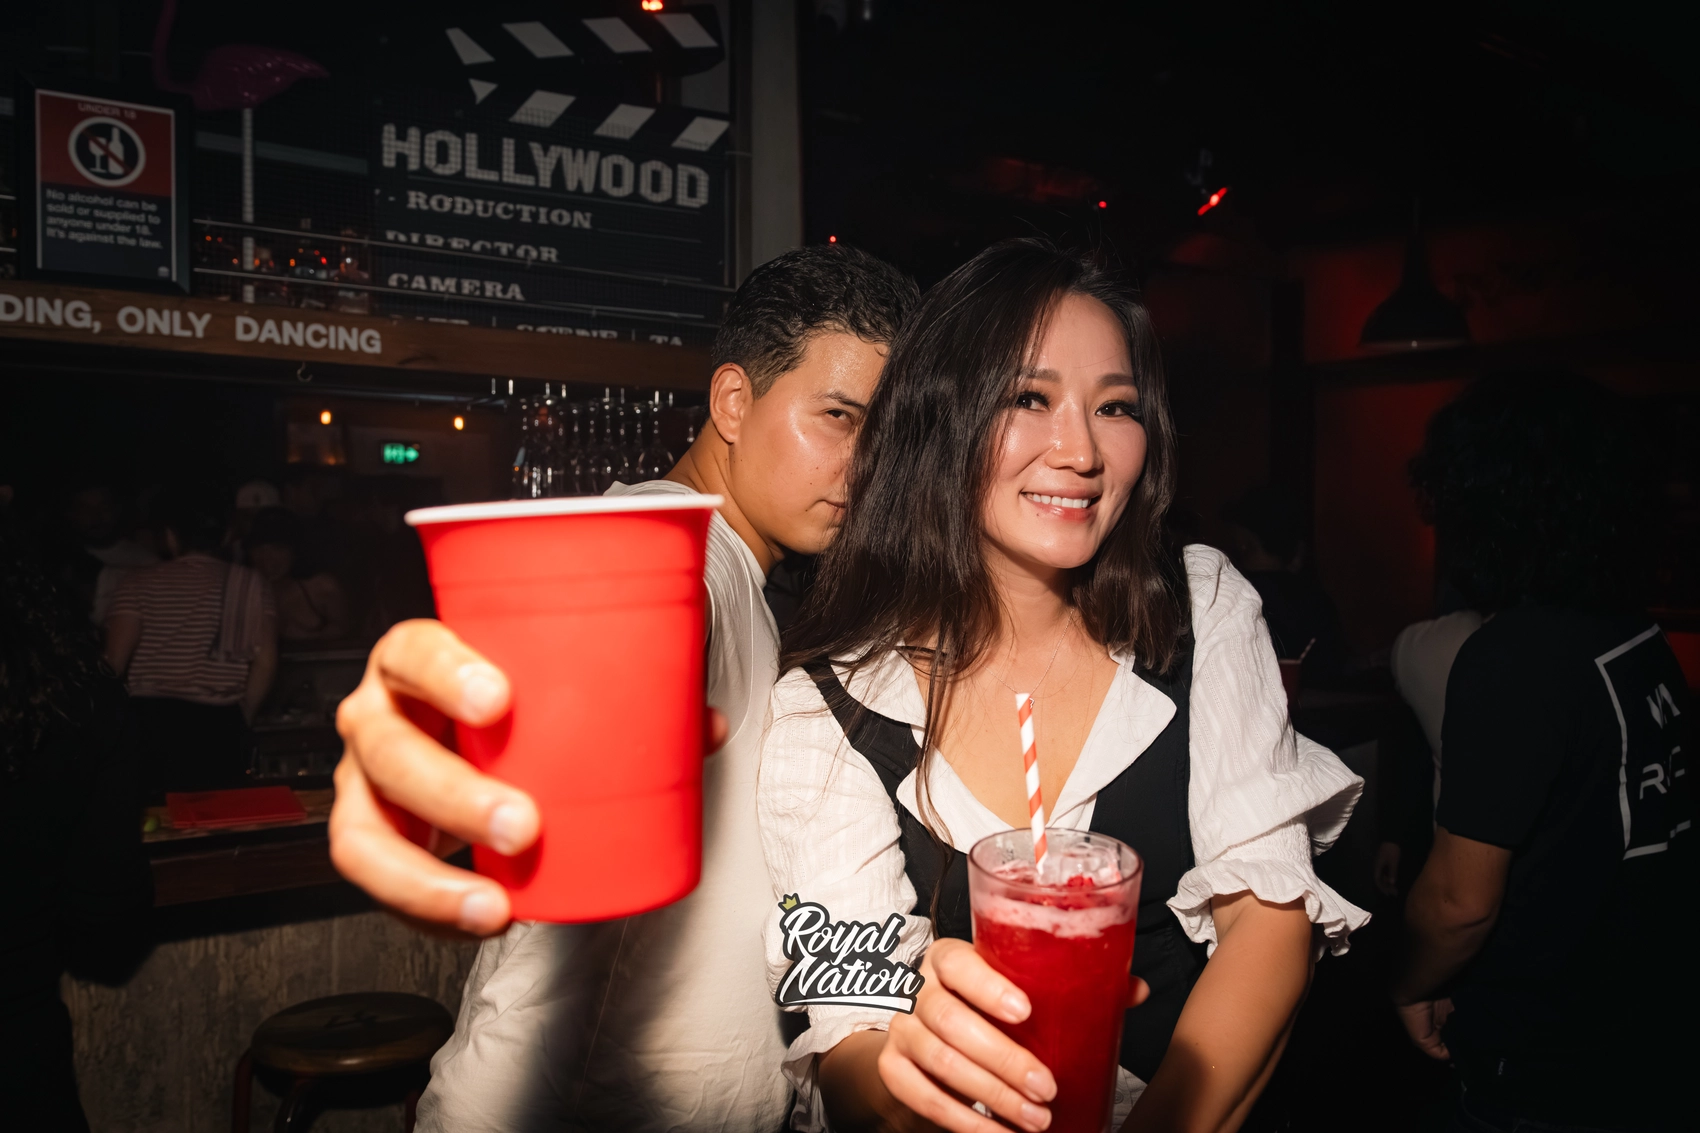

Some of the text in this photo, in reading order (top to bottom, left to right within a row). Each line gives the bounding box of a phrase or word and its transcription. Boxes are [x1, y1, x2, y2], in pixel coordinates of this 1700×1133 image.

[78, 102, 137, 120] UNDER 18
[381, 122, 709, 209] HOLLYWOOD
[46, 188, 158, 212] No alcohol can be
[388, 189, 593, 230] RODUCTION
[46, 203, 162, 225] sold or supplied to
[46, 215, 153, 236] anyone under 18.
[46, 227, 164, 249] It's against the law.
[387, 272, 527, 301] CAMERA
[0, 293, 383, 355] DING, ONLY DANCING
